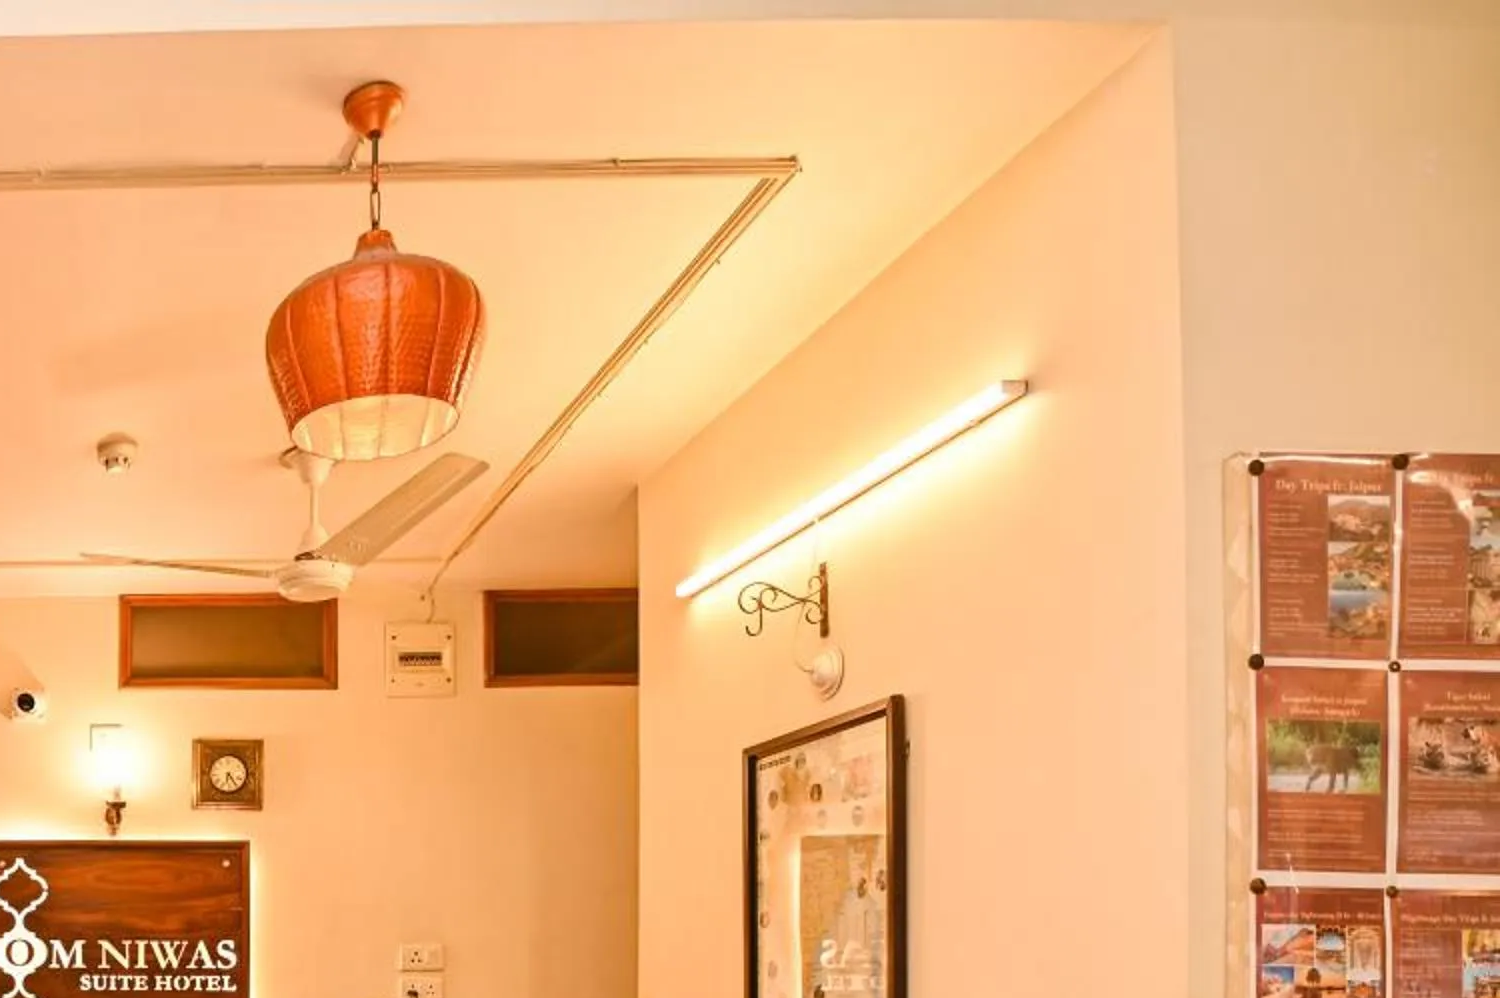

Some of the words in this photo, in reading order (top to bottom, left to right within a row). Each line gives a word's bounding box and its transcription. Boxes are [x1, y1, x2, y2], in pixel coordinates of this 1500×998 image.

[1275, 480, 1296, 494] Day
[6, 938, 88, 969] OM
[97, 938, 238, 970] NIWAS
[79, 974, 150, 992] SUITE
[153, 974, 238, 993] HOTEL
